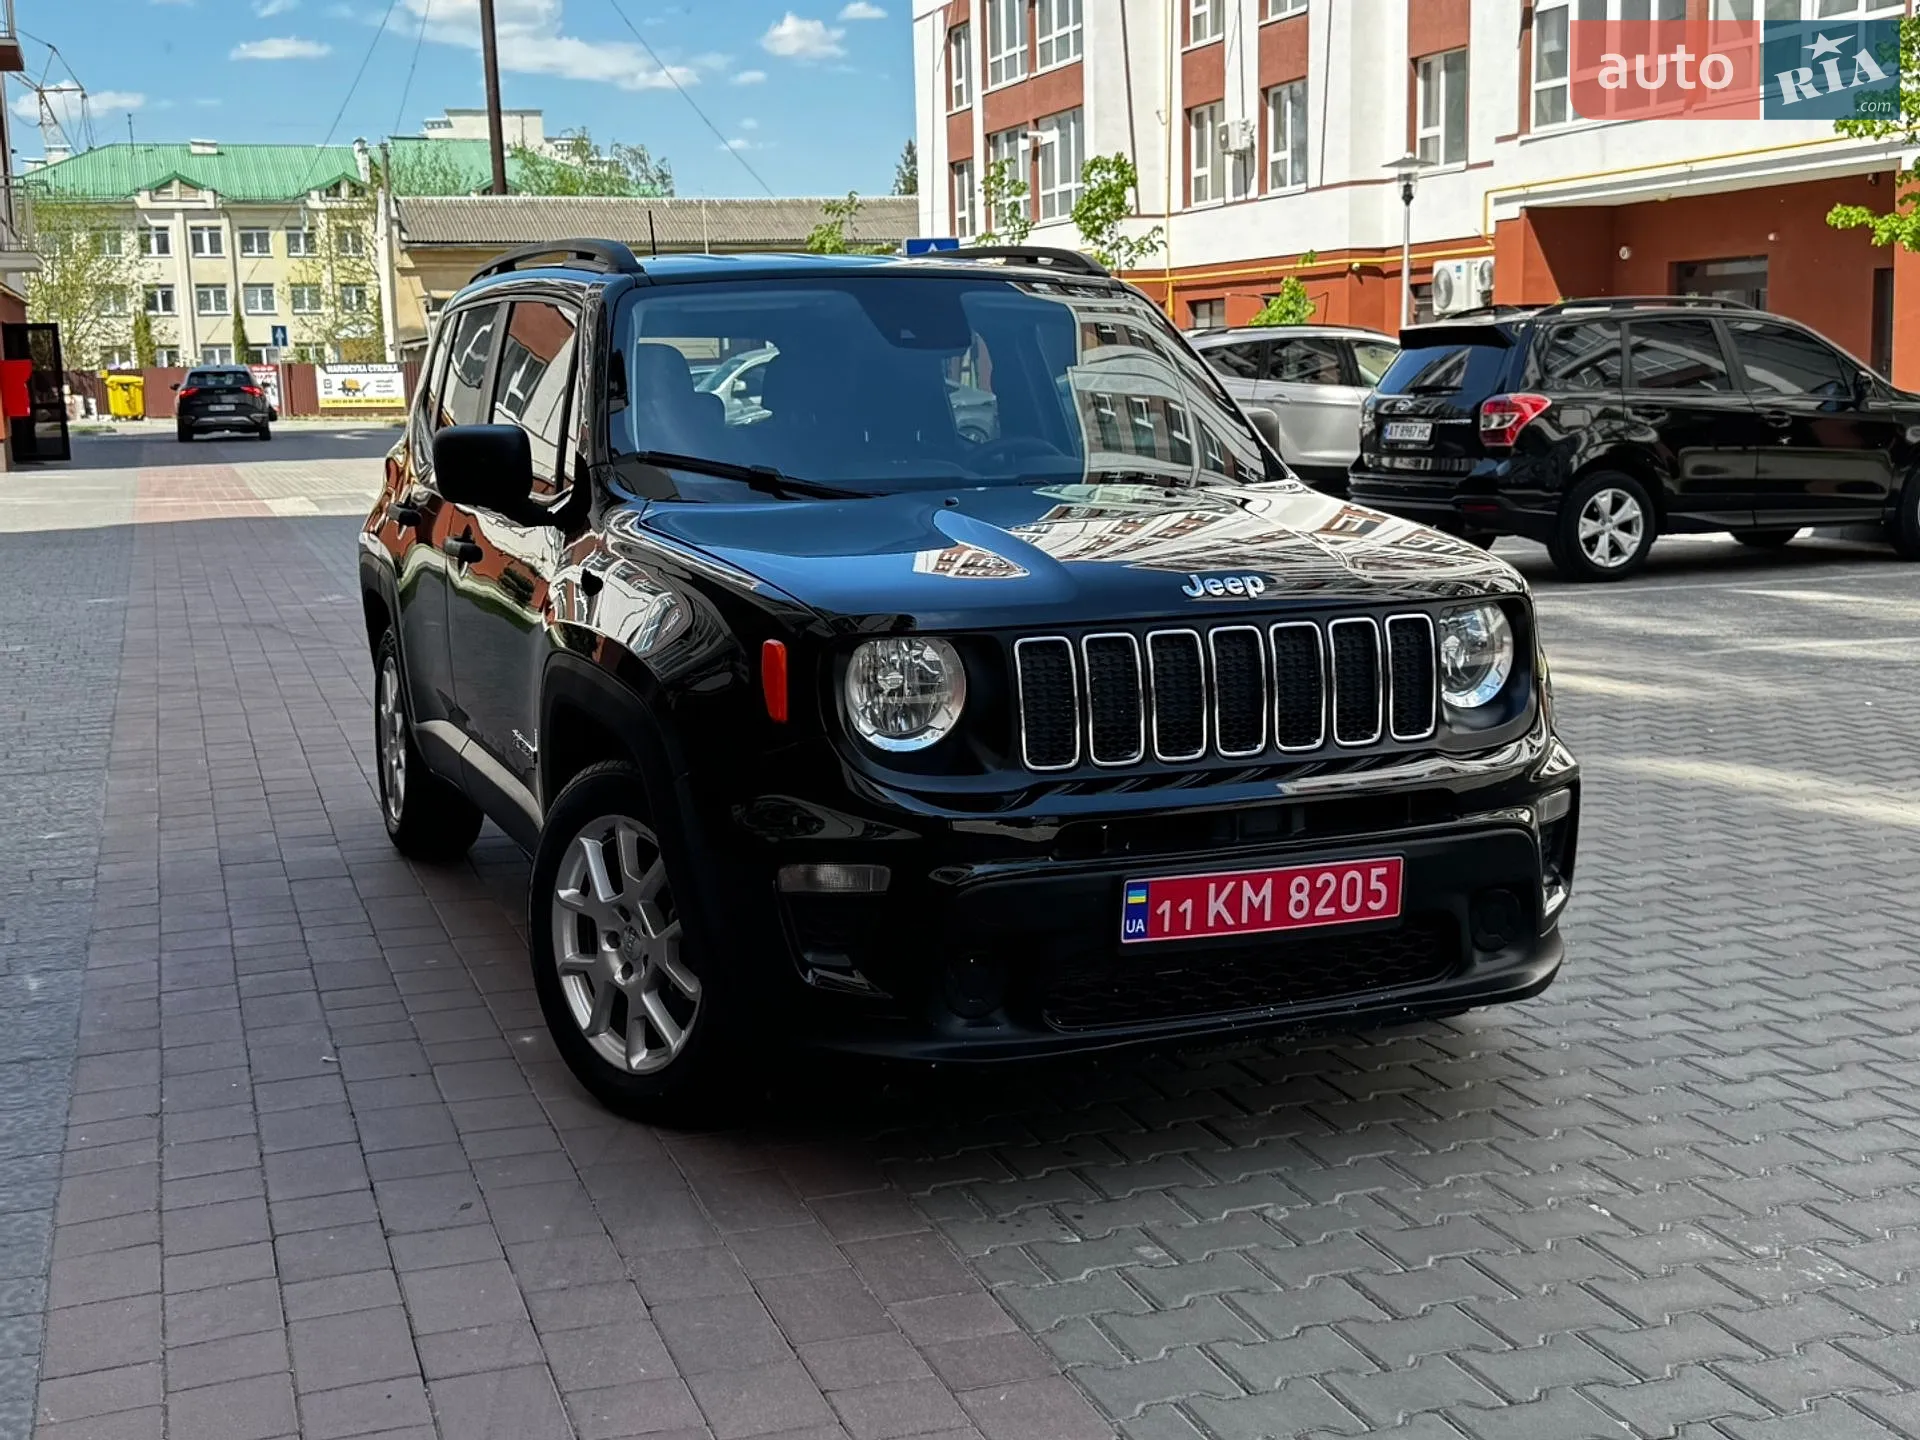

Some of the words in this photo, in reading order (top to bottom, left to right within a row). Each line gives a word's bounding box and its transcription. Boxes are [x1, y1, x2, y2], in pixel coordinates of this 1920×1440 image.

[1182, 574, 1265, 599] Jeep
[1156, 899, 1192, 932] 11
[1207, 878, 1272, 927] KM
[1288, 867, 1387, 919] 8205
[1126, 919, 1145, 933] UA
